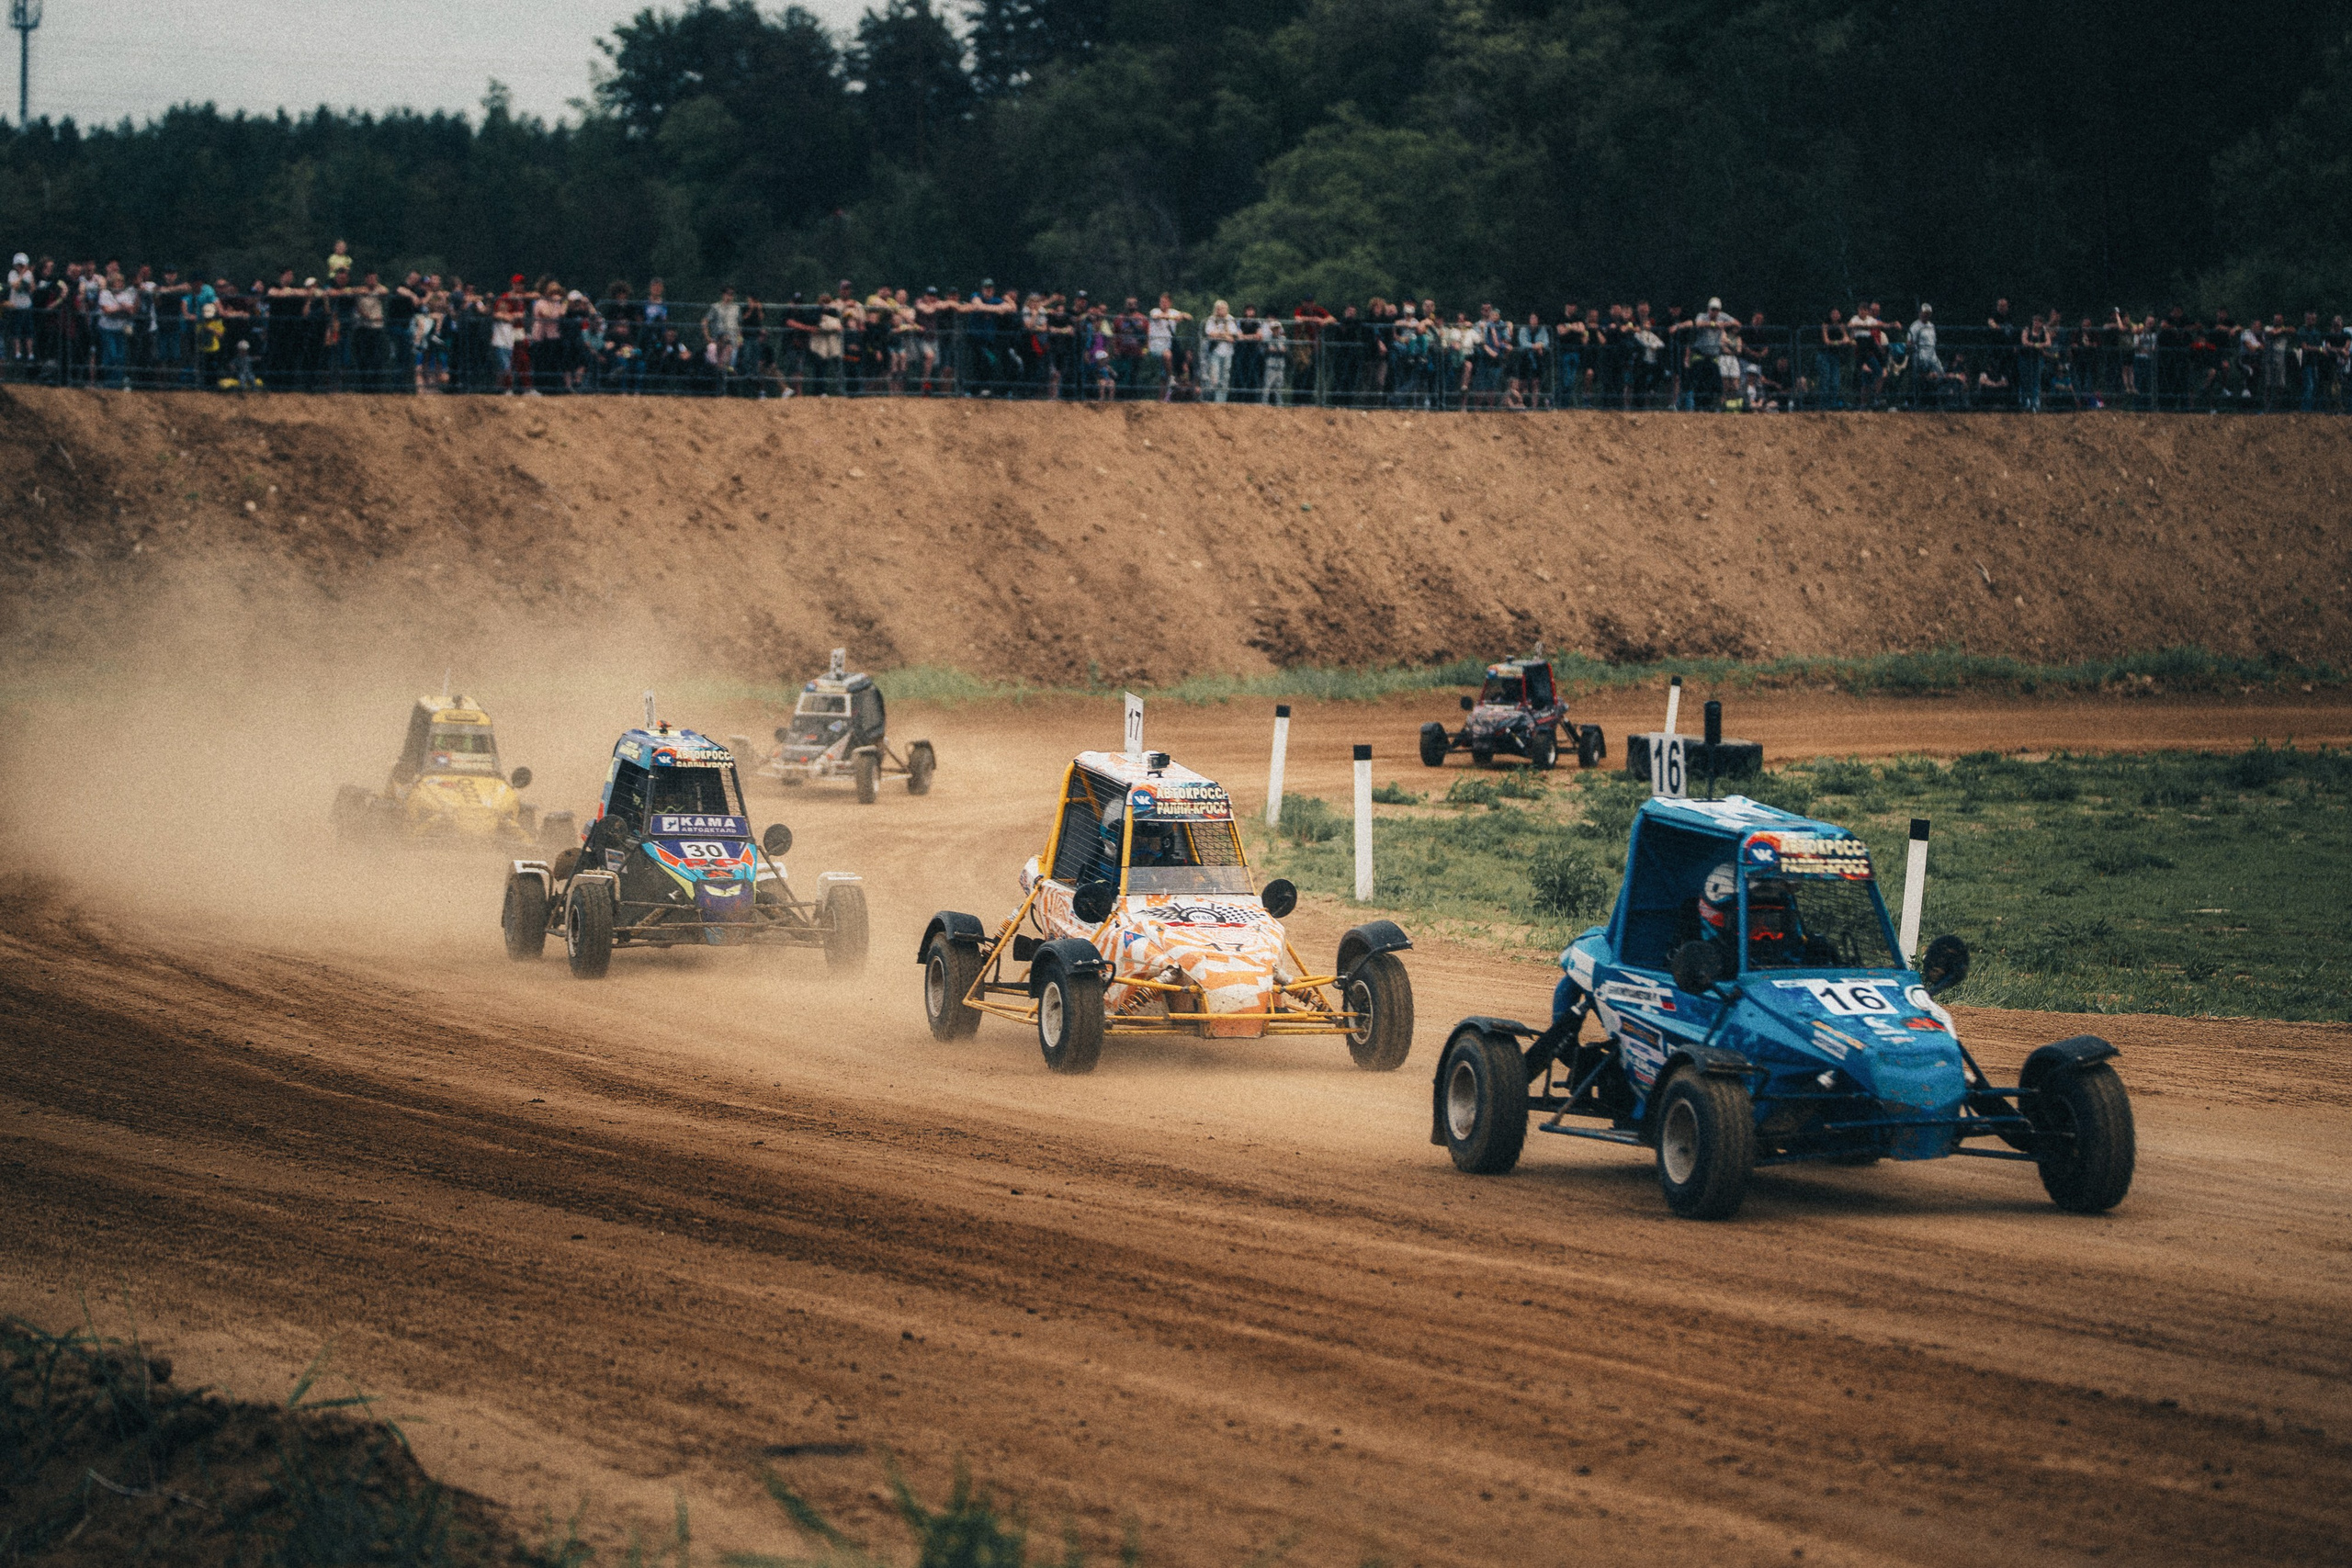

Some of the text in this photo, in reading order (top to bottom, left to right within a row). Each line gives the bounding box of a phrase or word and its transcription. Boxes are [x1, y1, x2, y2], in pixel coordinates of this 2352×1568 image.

[1129, 708, 1141, 740] 17
[1655, 739, 1680, 794] 16
[681, 817, 737, 827] КАМА
[687, 844, 722, 857] 30
[1819, 987, 1886, 1010] 16
